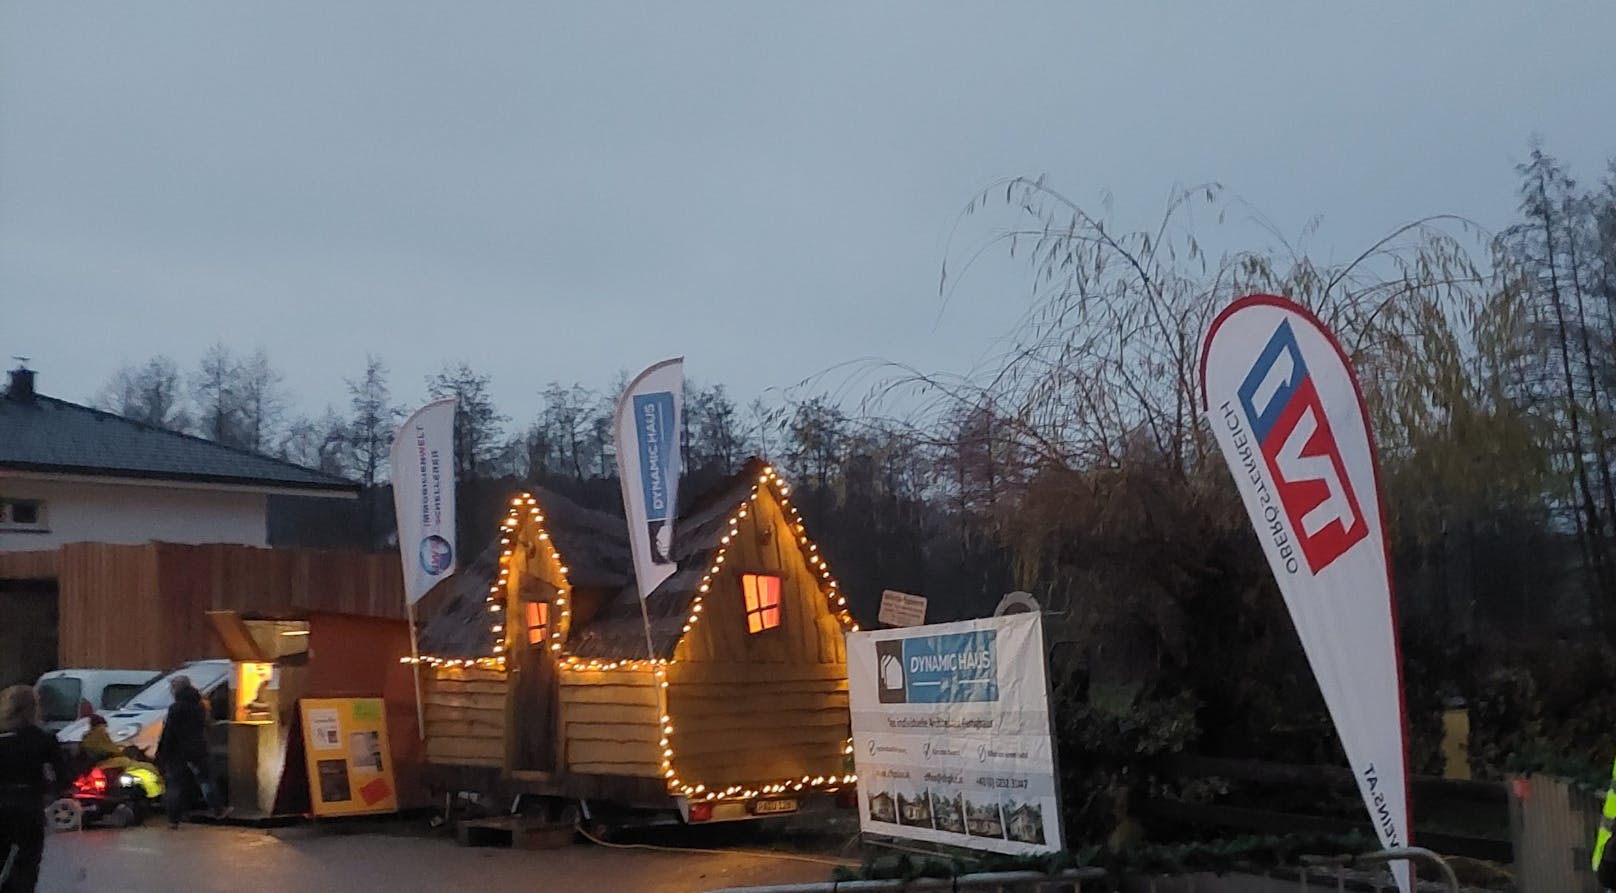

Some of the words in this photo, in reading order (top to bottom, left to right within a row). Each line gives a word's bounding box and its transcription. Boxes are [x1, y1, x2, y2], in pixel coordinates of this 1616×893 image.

[643, 402, 658, 442] HAUS
[416, 424, 432, 527] IMMOBILIENWELT
[648, 444, 664, 510] DYNAMIC
[910, 653, 957, 673] DYNAMIC
[958, 650, 991, 670] HAUS
